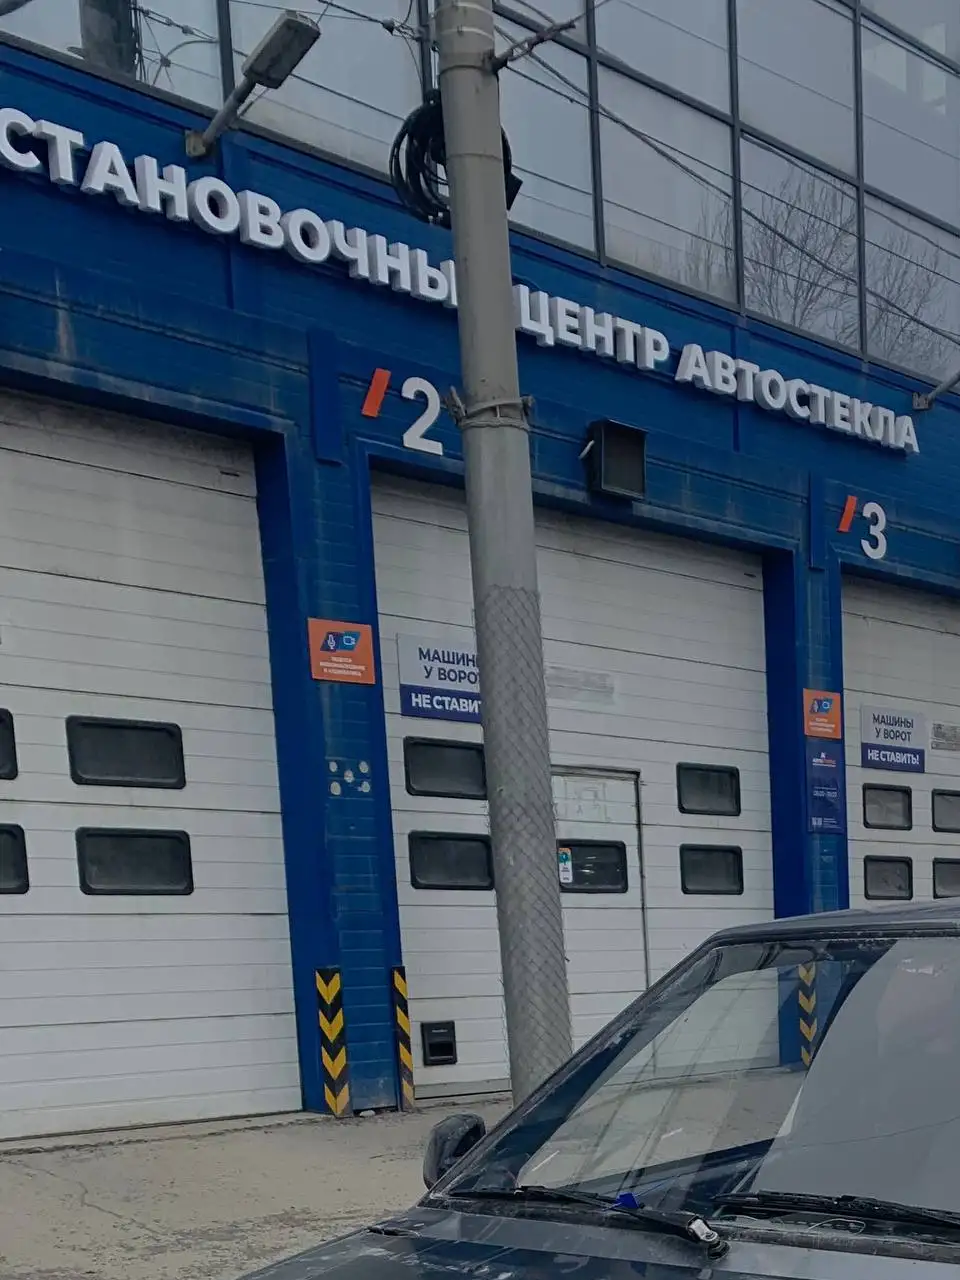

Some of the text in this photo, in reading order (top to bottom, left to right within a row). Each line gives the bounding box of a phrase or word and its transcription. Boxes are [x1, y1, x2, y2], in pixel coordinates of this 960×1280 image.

[0, 108, 920, 454] СТАНОВОЧНЫ ЦЕНТР АВТОСТЕКЛА
[418, 647, 476, 667] МАШИН
[424, 665, 480, 684] У ВОРО
[411, 692, 482, 713] НЕ СТАВИ
[872, 713, 914, 729] МАШИНЫ
[875, 727, 912, 742] У ВОРОТ
[867, 749, 920, 765] НЕ СТАВИТЬ!
